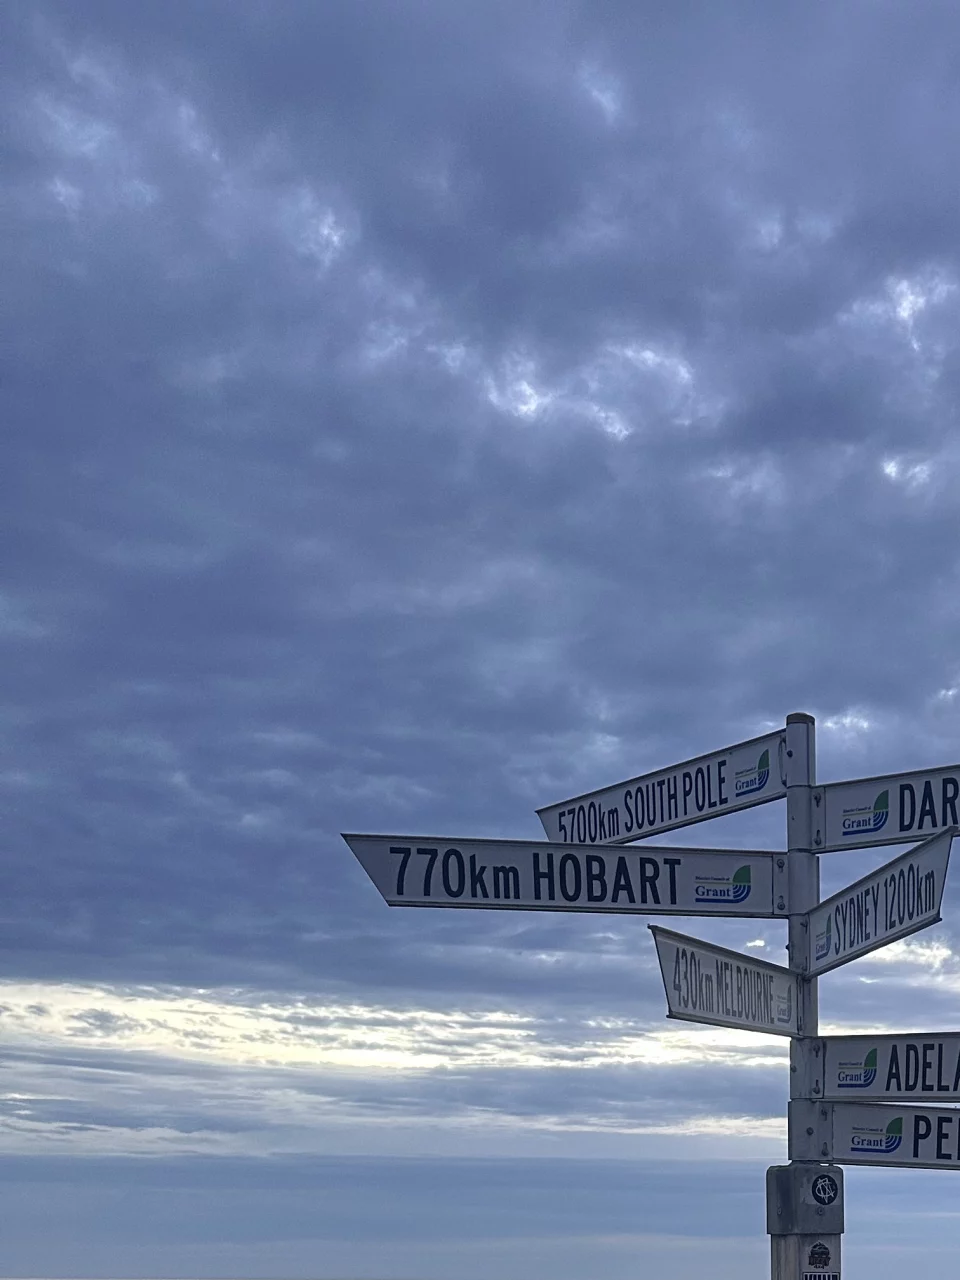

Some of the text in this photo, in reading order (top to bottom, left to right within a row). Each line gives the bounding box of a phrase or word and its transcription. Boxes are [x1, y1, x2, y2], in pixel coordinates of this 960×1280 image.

[558, 760, 729, 843] 5700km SOUTH POLE
[842, 816, 872, 829] Grant
[389, 846, 682, 906] 770km HOBART
[695, 885, 731, 897] Grant
[834, 863, 935, 956] SYDNEY 1200km
[673, 947, 775, 1025] 430km MELBOURNE
[837, 1070, 862, 1083] Grant
[851, 1135, 884, 1147] Grant
